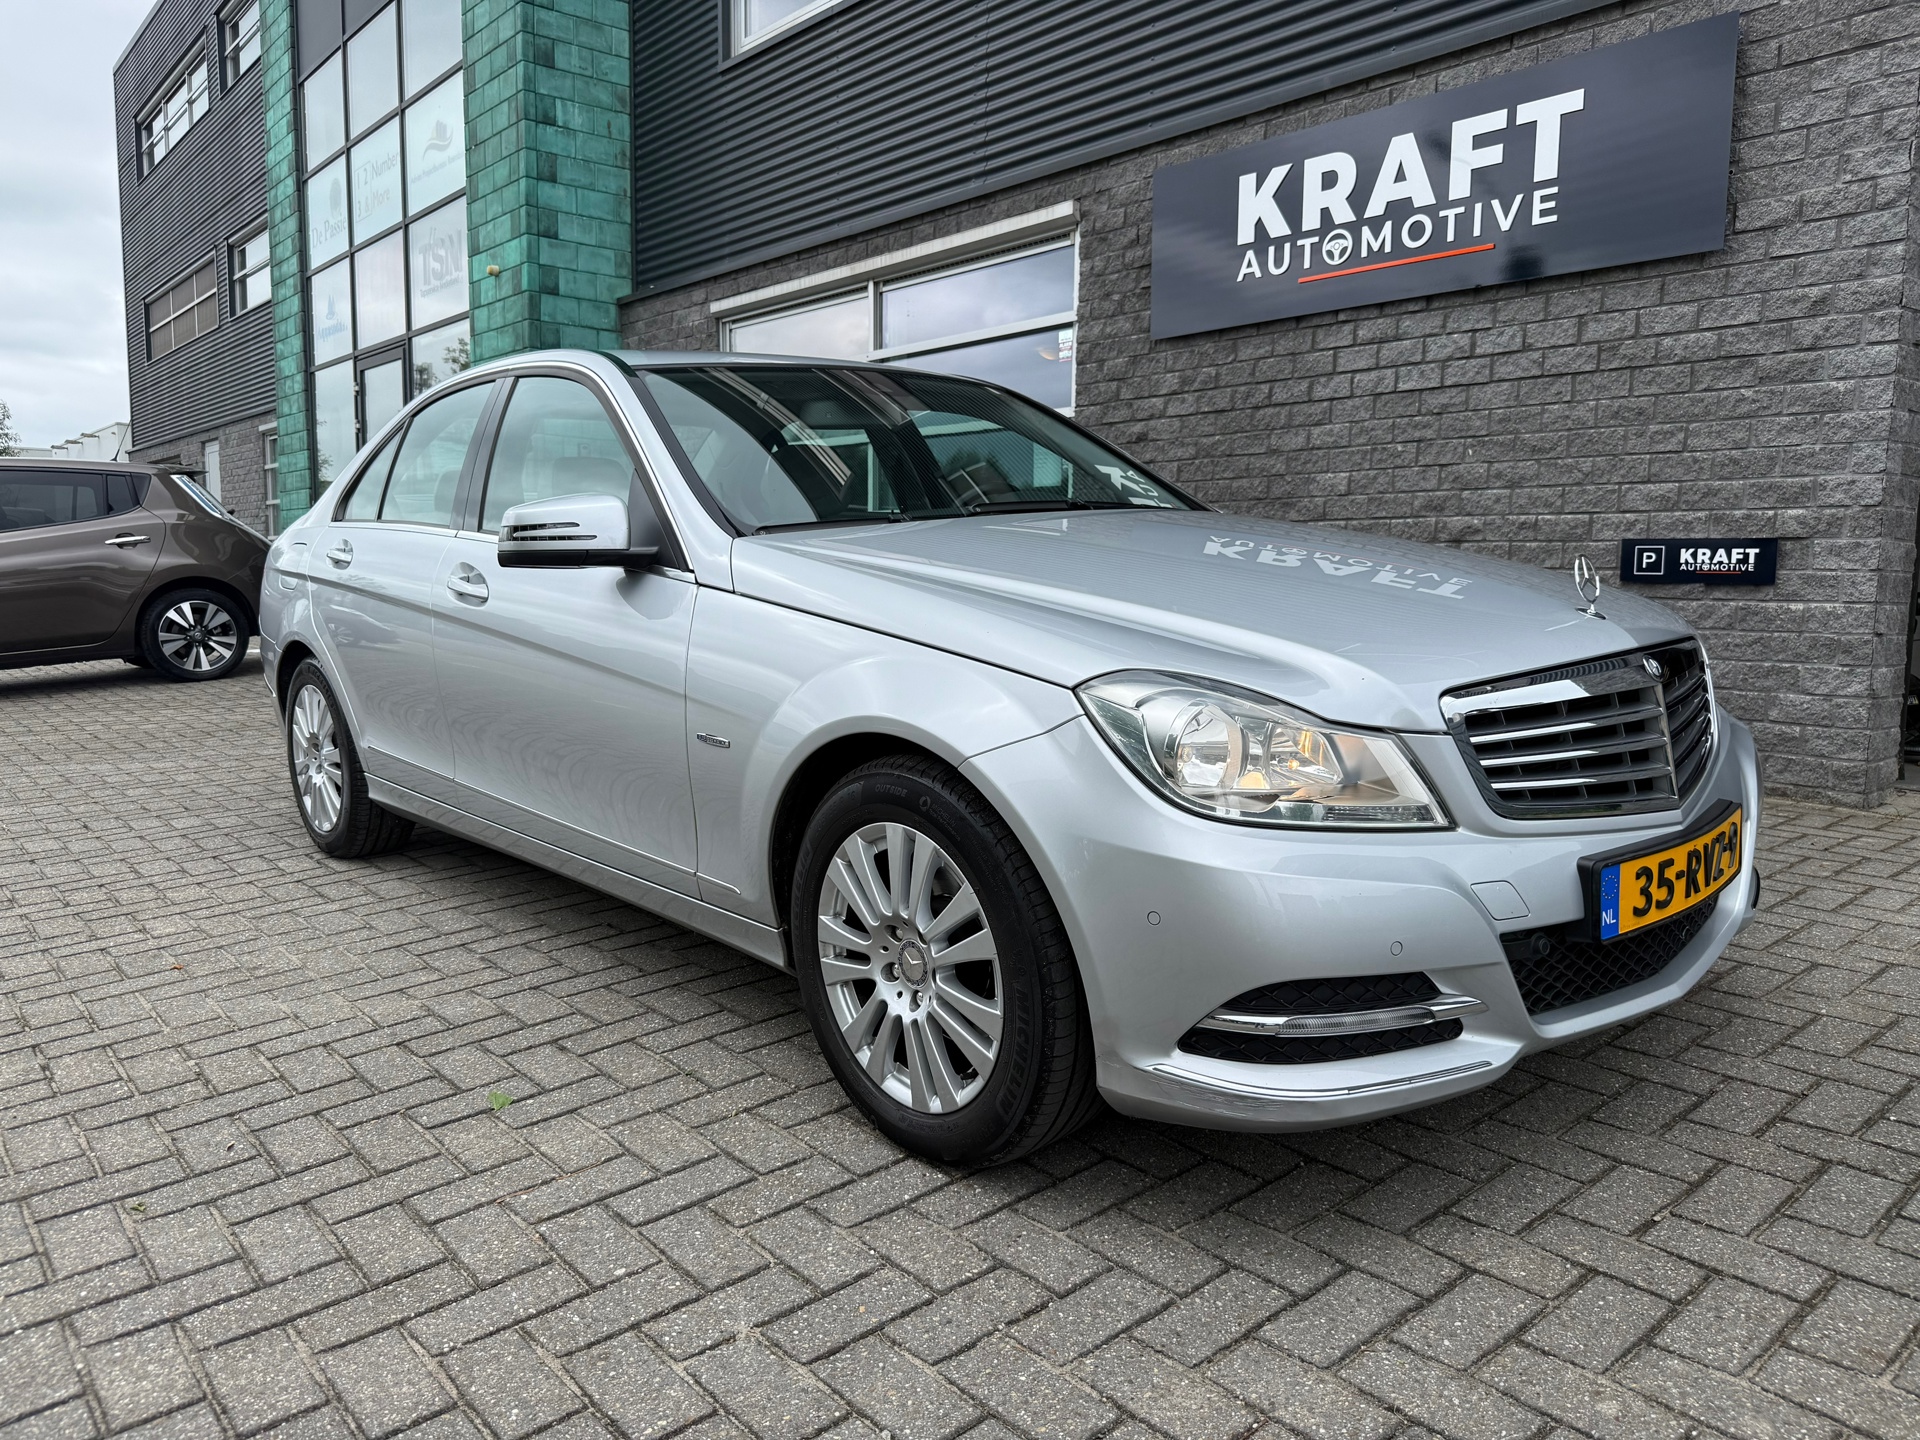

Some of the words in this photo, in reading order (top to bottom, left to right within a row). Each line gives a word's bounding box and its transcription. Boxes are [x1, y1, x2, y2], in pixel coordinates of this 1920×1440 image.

[363, 167, 368, 186] 2
[371, 152, 399, 179] Number
[1237, 88, 1585, 246] KRAFT
[373, 188, 390, 209] More
[311, 226, 323, 248] De
[324, 216, 347, 241] Passie
[1236, 186, 1559, 282] AUTOMOTIVE
[418, 227, 463, 286] TSN
[1642, 552, 1656, 568] P
[1679, 548, 1760, 564] KRAFT
[1679, 563, 1755, 572] AUTOMOTIVE
[874, 783, 908, 797] OUTSIDE
[931, 803, 957, 827] MICHELIN
[1632, 822, 1738, 918] 35-RVZ-9
[1602, 908, 1616, 926] NL
[998, 987, 1031, 1116] MICHELIN
